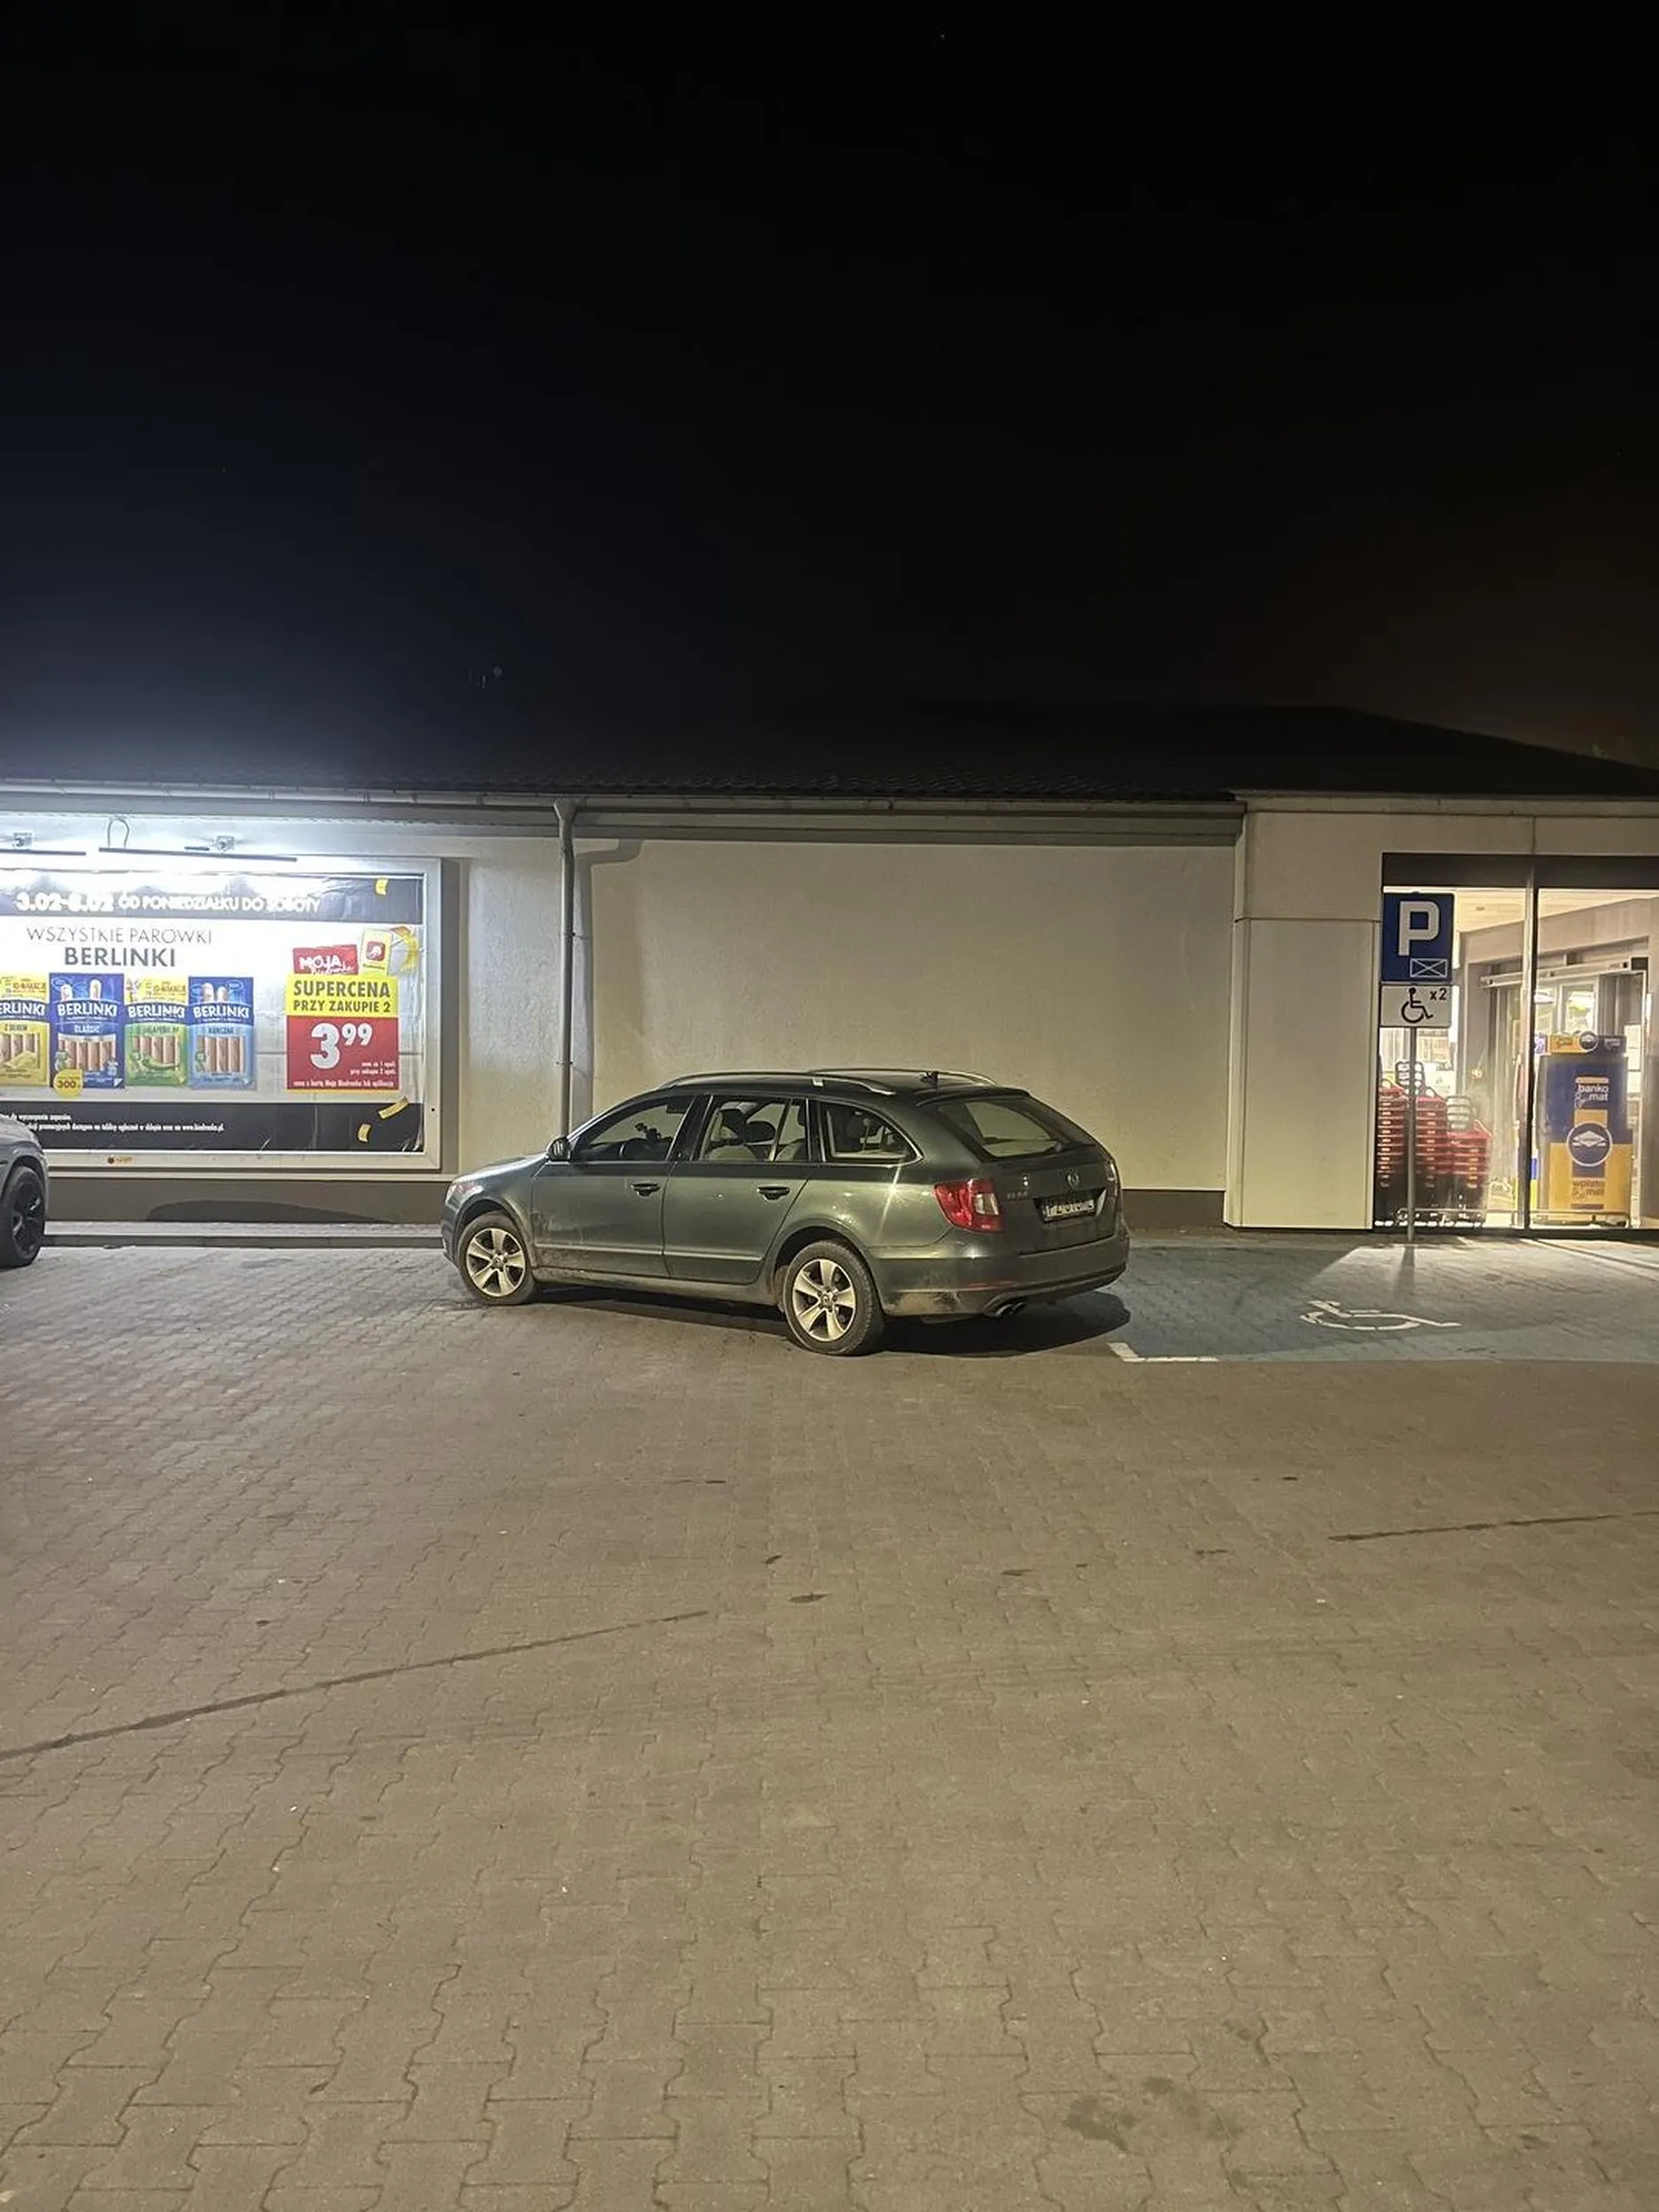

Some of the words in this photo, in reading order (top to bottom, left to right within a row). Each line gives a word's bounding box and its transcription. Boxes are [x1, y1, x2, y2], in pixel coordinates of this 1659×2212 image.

[119, 893, 140, 910] OD
[142, 895, 238, 911] PONIEDZIAŁKU
[242, 896, 264, 912] DO
[266, 897, 320, 913] SOBOTY
[27, 926, 124, 943] WSZYSTKIE
[1398, 901, 1440, 956] P
[65, 947, 175, 966] BERLINKI
[298, 955, 342, 970] MOJA
[294, 980, 390, 997] SUPERCENA
[58, 1002, 118, 1017] BERLINKI
[127, 1004, 185, 1018] BERLINKI
[193, 1005, 250, 1018] BERLINKI
[293, 1000, 325, 1011] PRZY
[329, 1001, 380, 1012] ZAKUPIE
[383, 1002, 391, 1012] 2
[1578, 1084, 1609, 1093] banko
